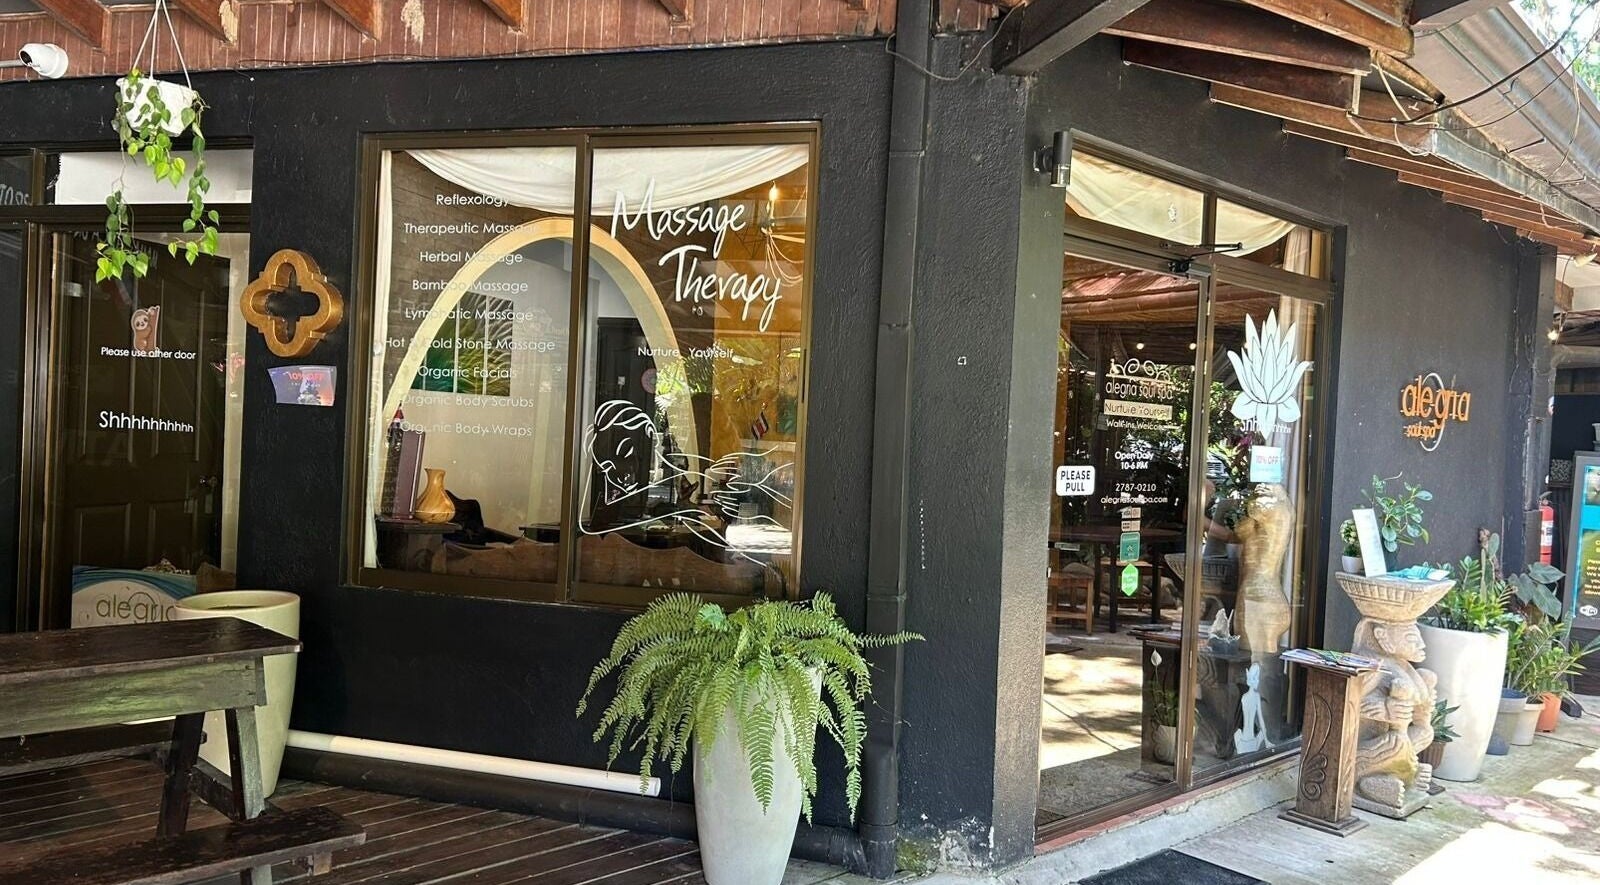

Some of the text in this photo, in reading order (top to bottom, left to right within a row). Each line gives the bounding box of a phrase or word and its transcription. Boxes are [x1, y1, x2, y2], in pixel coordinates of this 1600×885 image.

[436, 193, 510, 207] Reflexology
[611, 177, 746, 260] Massage
[404, 222, 479, 236] Therapeutic
[420, 251, 523, 265] Herbal Mage
[471, 280, 529, 293] Massage
[658, 245, 782, 332] Therapy
[405, 308, 534, 322] Lympatic Massage
[425, 338, 452, 349] old
[456, 338, 492, 350] Stone
[496, 339, 556, 352] Massage
[101, 346, 196, 360] Please use other door
[638, 347, 734, 358] Nurture Yourself
[417, 366, 517, 379] Organic Facials
[456, 395, 488, 409] Body
[491, 396, 534, 408] Scrubs
[456, 422, 488, 435] Body
[491, 423, 532, 437] Wraps
[1115, 451, 1135, 461] Open
[1060, 469, 1091, 481] PLEASE
[1065, 481, 1085, 493] PULL
[1115, 483, 1157, 492] 2787-0210
